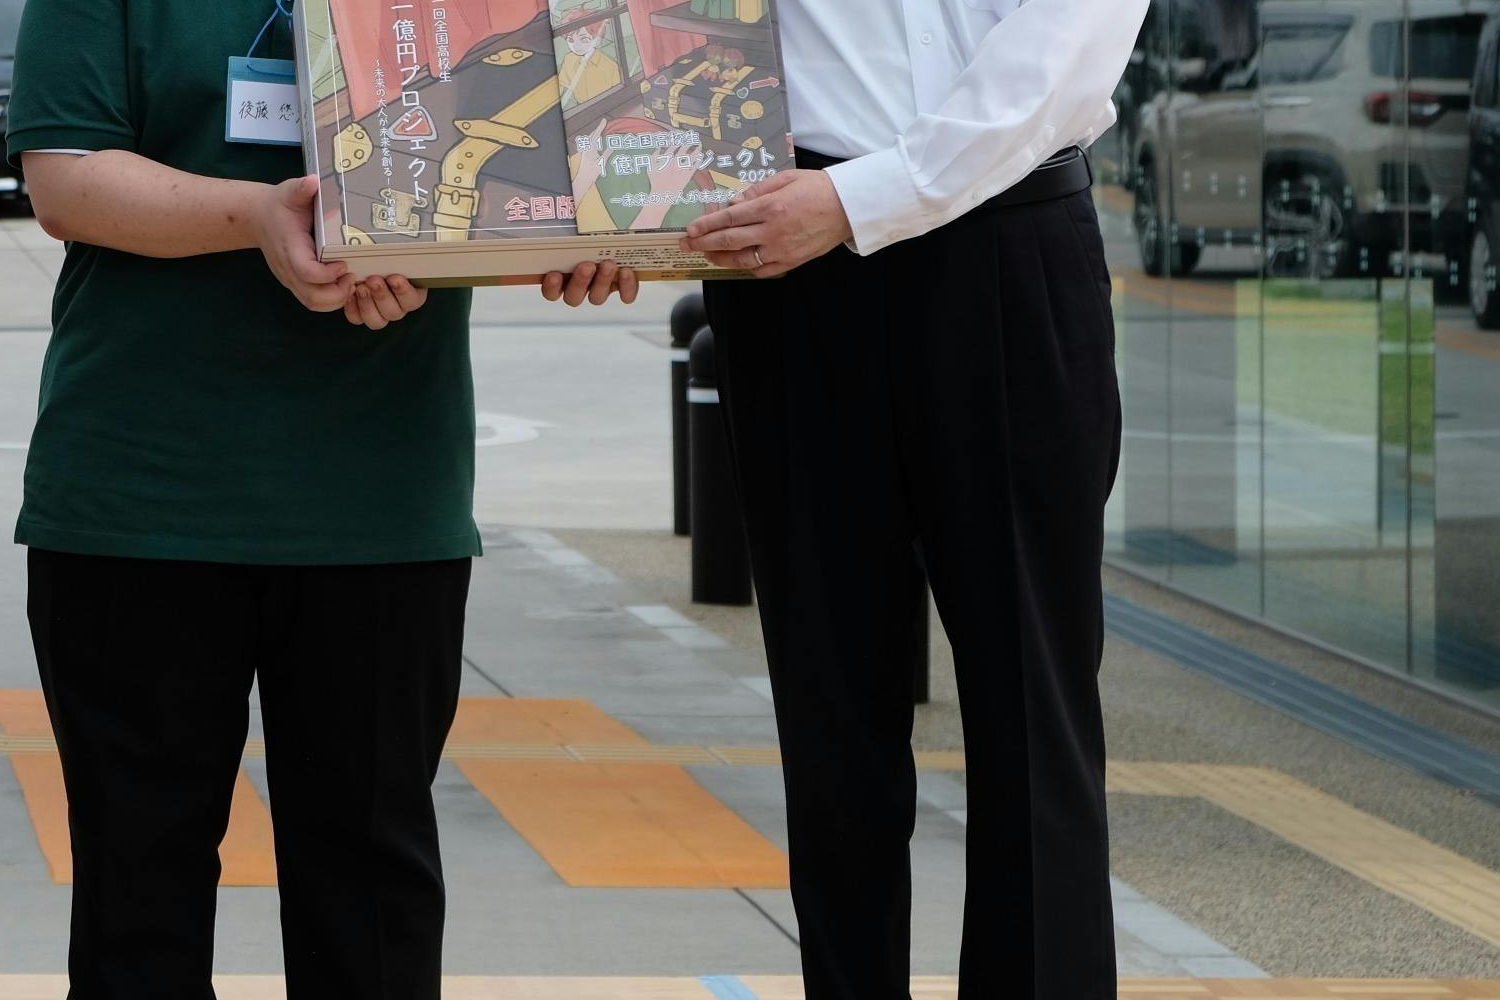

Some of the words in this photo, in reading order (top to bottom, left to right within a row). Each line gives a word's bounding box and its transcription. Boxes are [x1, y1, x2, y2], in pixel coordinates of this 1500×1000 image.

[391, 3, 428, 201] 一億円プロジェクト
[575, 129, 701, 151] 第1回全国高校生
[597, 146, 776, 178] 1億円プロジェクト
[504, 195, 577, 221] 全国版
